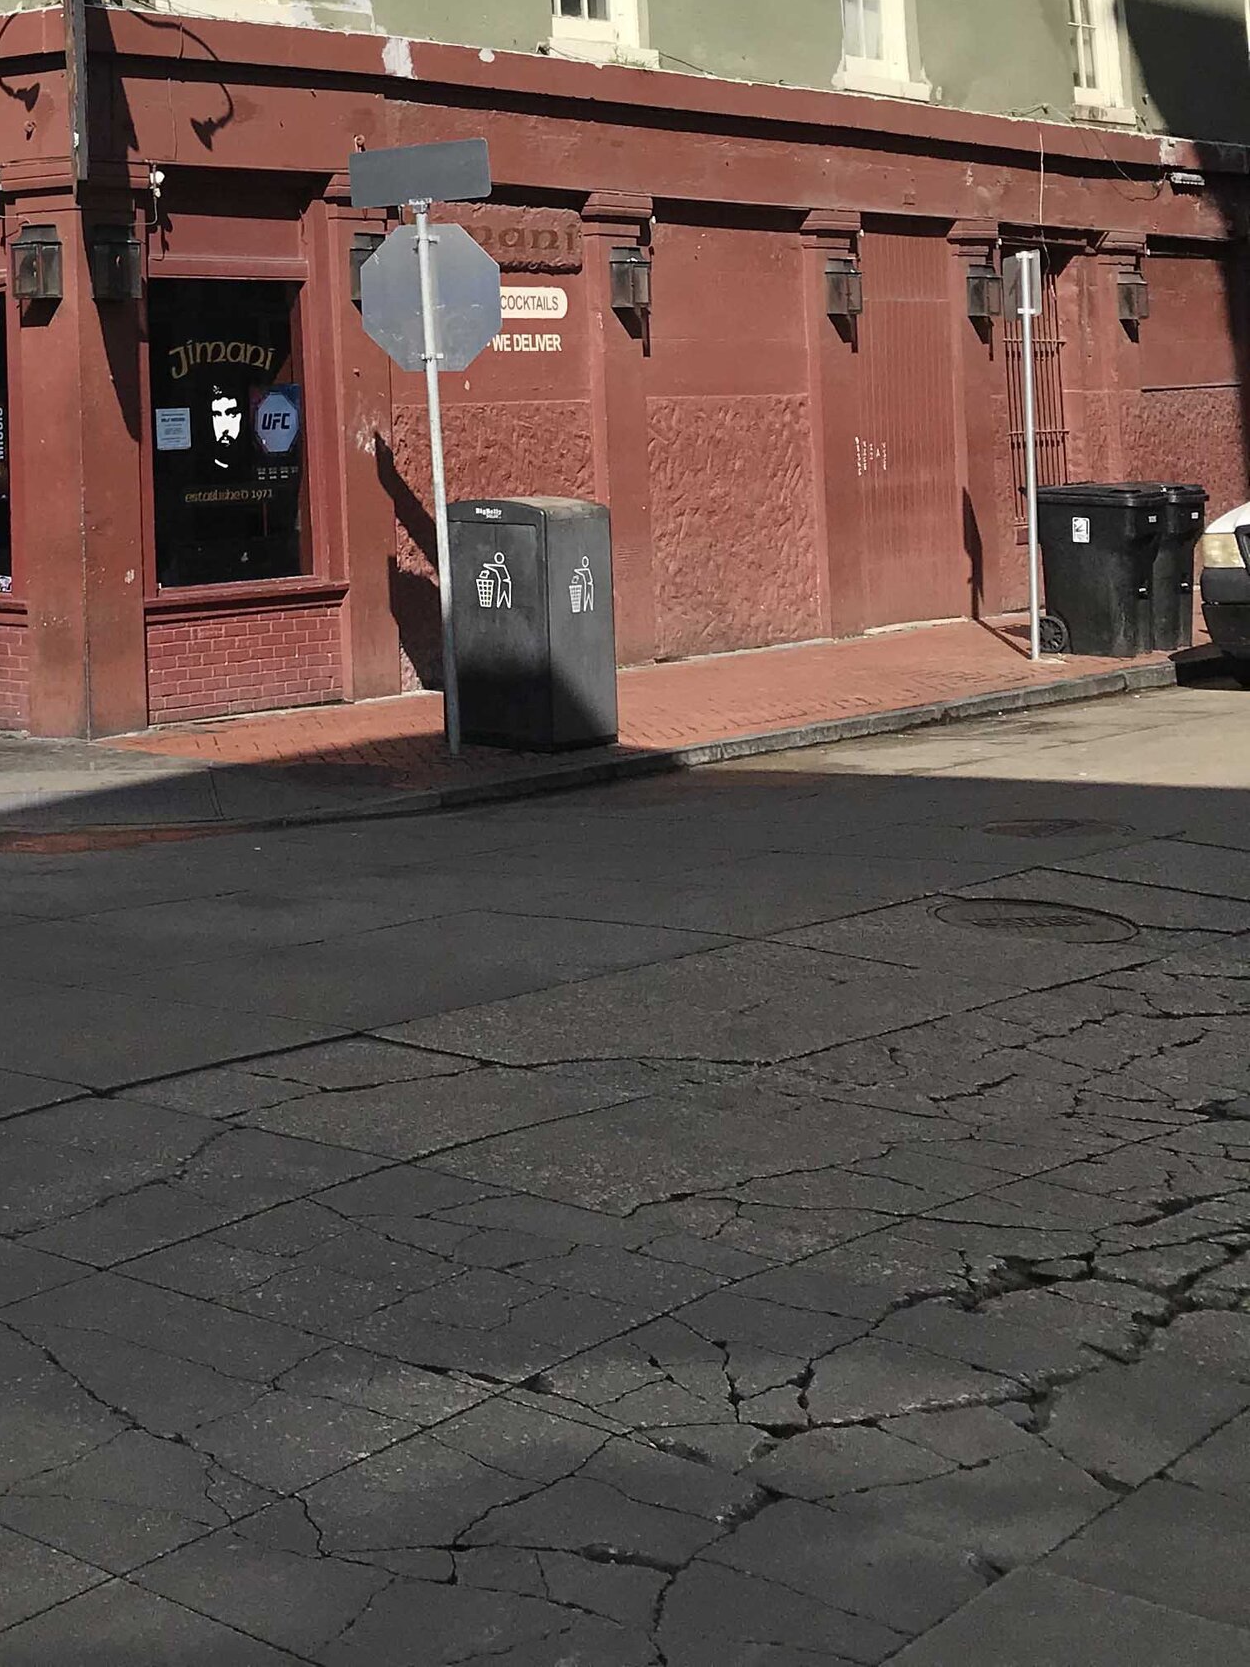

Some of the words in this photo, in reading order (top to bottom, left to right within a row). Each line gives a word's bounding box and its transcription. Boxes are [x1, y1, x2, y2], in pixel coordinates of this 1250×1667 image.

[500, 294, 559, 312] COCKTAILS
[492, 334, 512, 352] WE
[513, 334, 563, 352] DELIVER
[168, 339, 278, 380] Jimani
[261, 412, 291, 431] UFC
[250, 488, 273, 502] 1971
